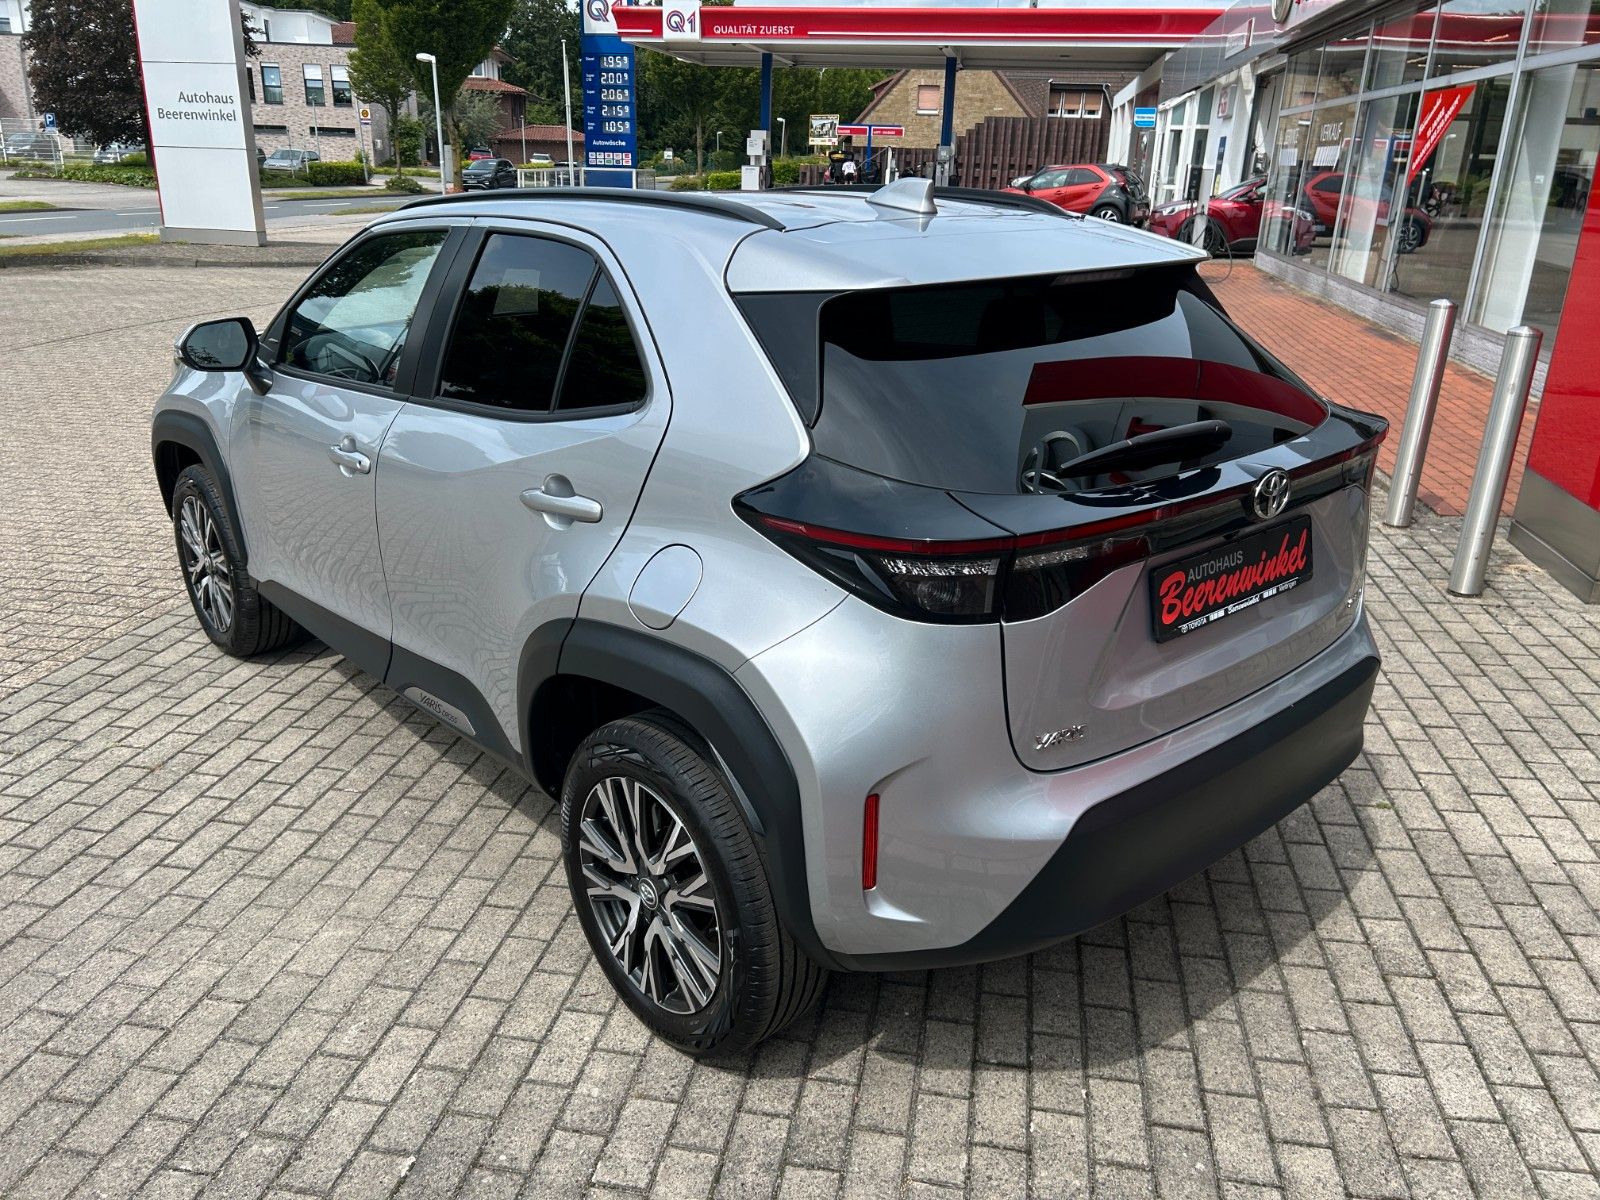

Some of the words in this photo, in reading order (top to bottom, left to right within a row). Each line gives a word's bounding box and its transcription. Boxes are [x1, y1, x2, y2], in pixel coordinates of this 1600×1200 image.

[667, 10, 696, 33] Q1
[713, 24, 757, 35] QUALITÄT
[759, 25, 795, 35] ZUERST
[178, 91, 234, 104] Autohaus
[45, 113, 54, 125] P
[157, 107, 237, 122] Beerenwinkel
[1187, 550, 1244, 583] AUTOHAUS
[1159, 528, 1308, 625] Beerenwinkel
[1188, 617, 1207, 630] TOYOTA
